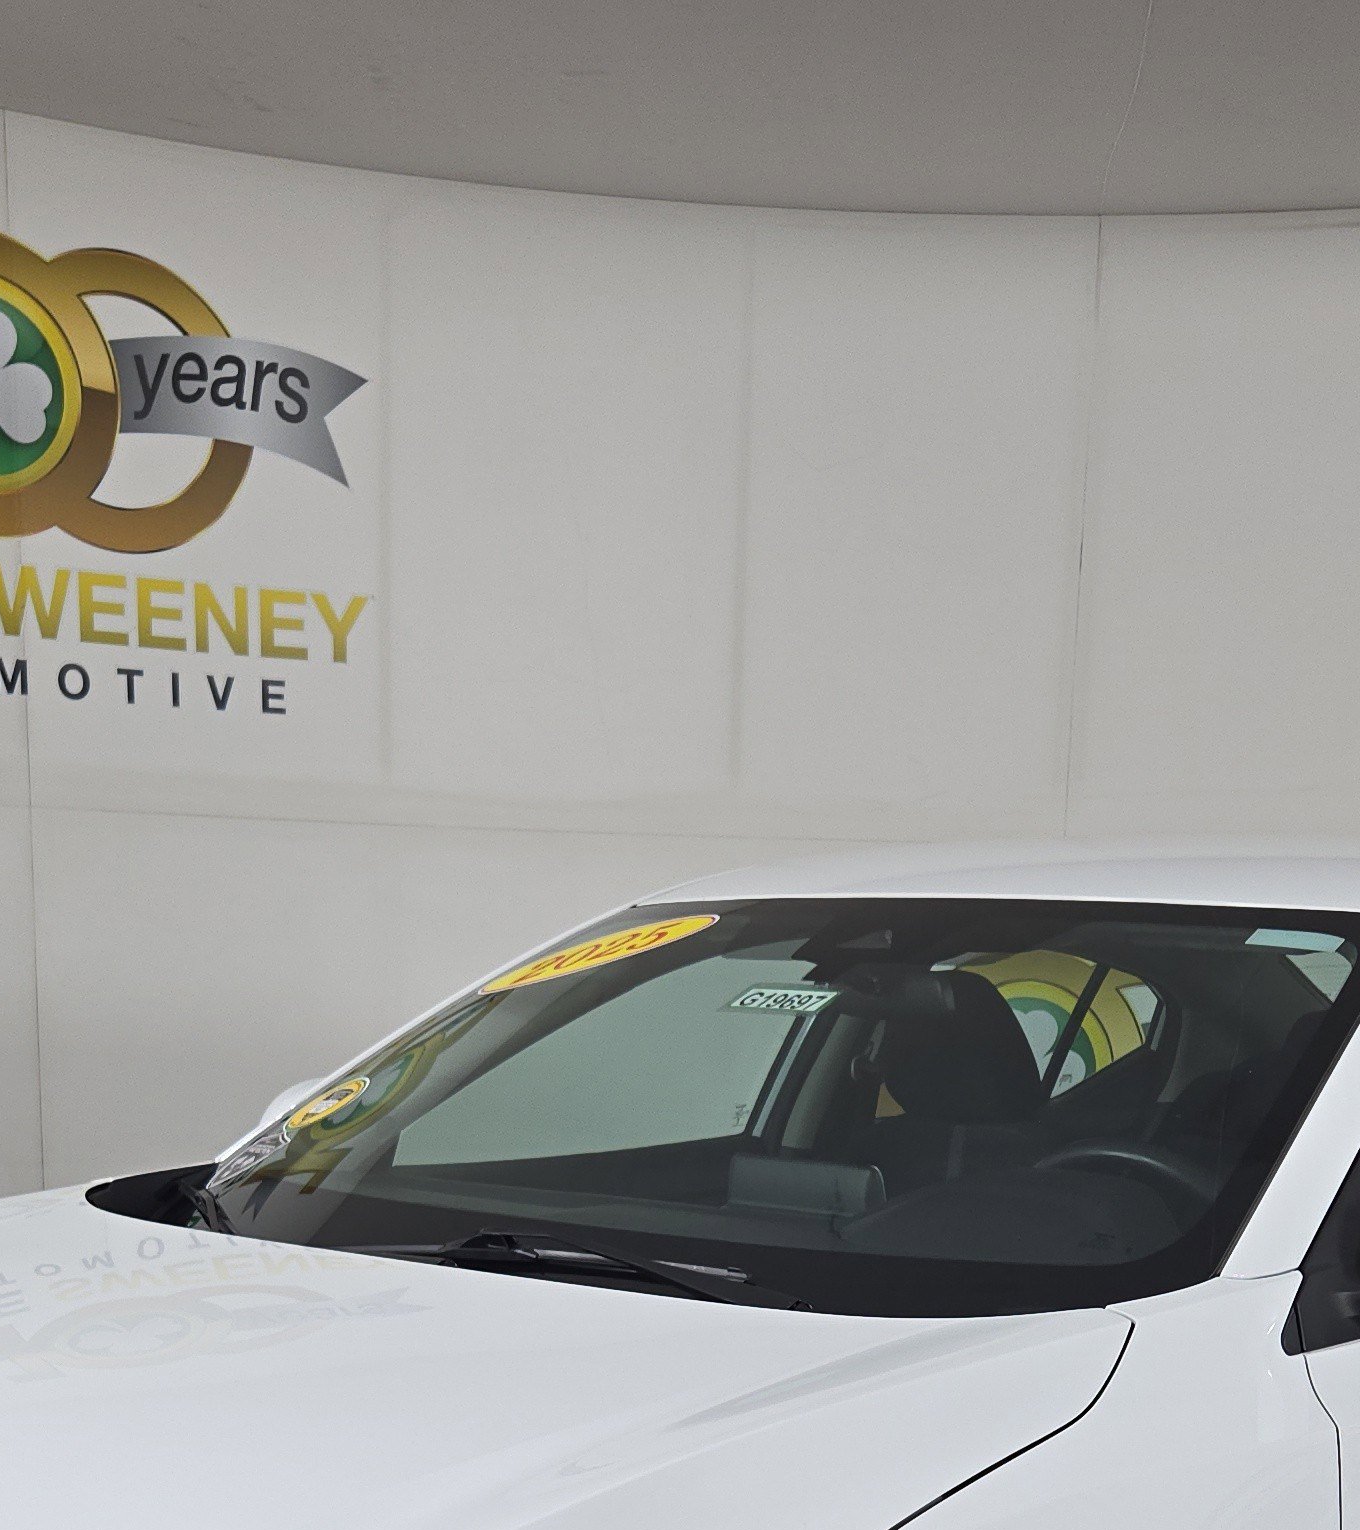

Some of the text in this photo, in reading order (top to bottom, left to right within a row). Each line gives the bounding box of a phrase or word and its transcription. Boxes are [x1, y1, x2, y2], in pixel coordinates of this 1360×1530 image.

[132, 349, 311, 423] years
[509, 921, 684, 986] 2025
[740, 992, 828, 1011] G19697
